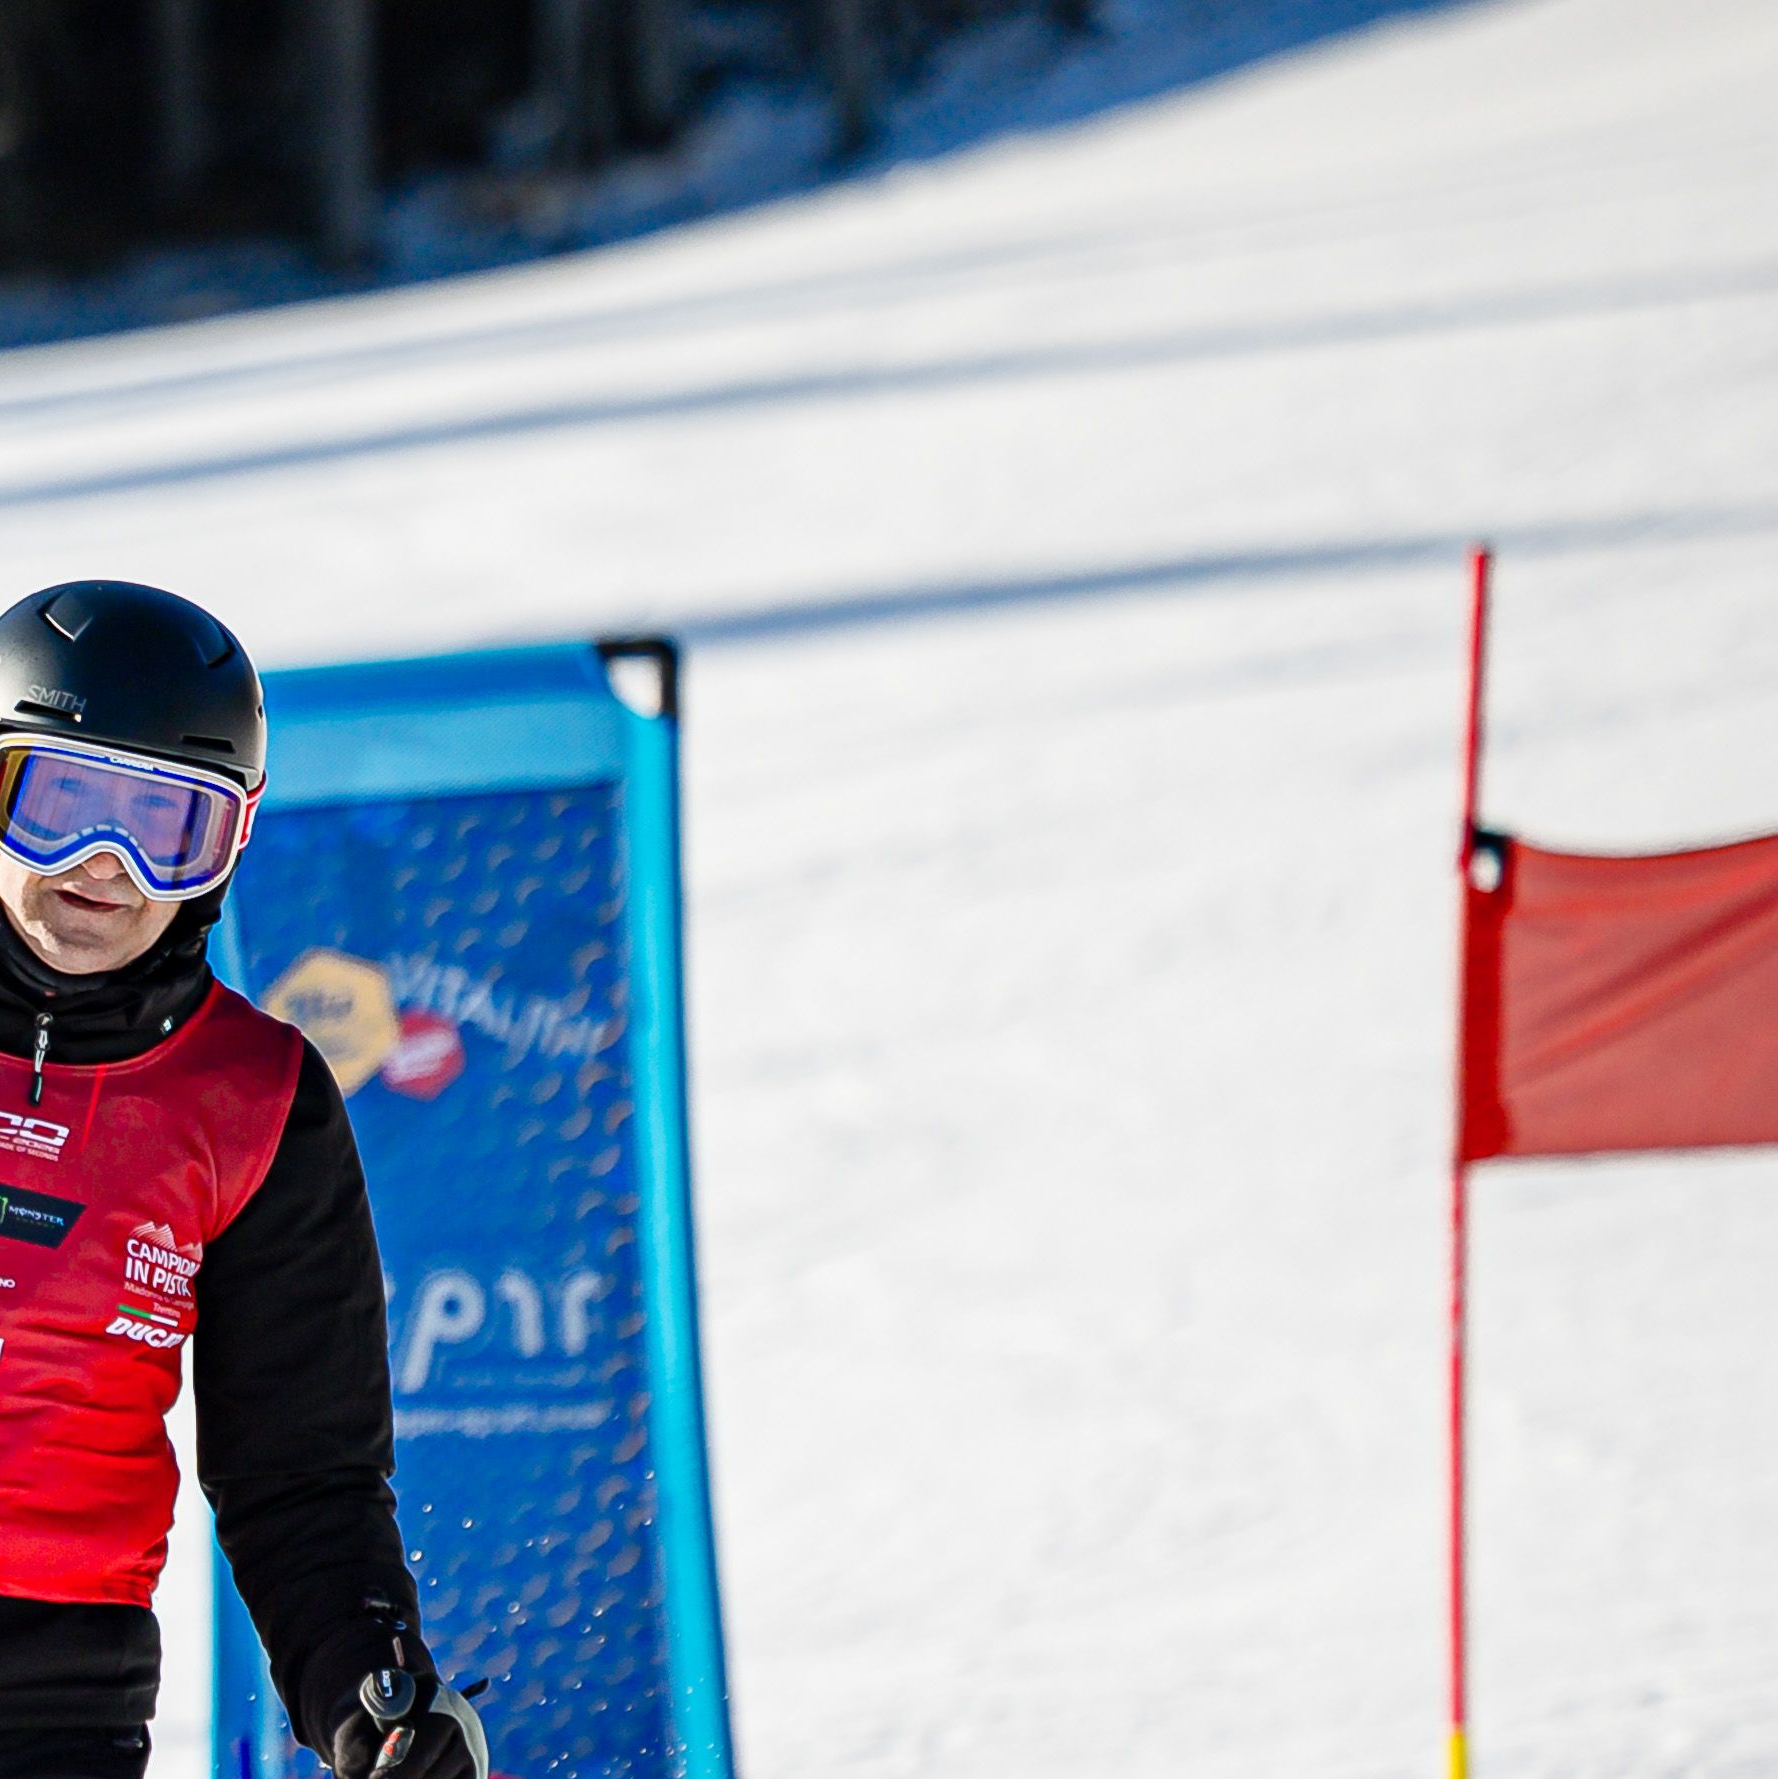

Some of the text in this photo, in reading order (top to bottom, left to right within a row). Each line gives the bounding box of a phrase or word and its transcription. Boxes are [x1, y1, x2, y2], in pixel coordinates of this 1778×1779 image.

[27, 684, 86, 712] SMITH
[8, 1205, 65, 1226] MONSTER
[125, 1257, 191, 1297] IN PISTA
